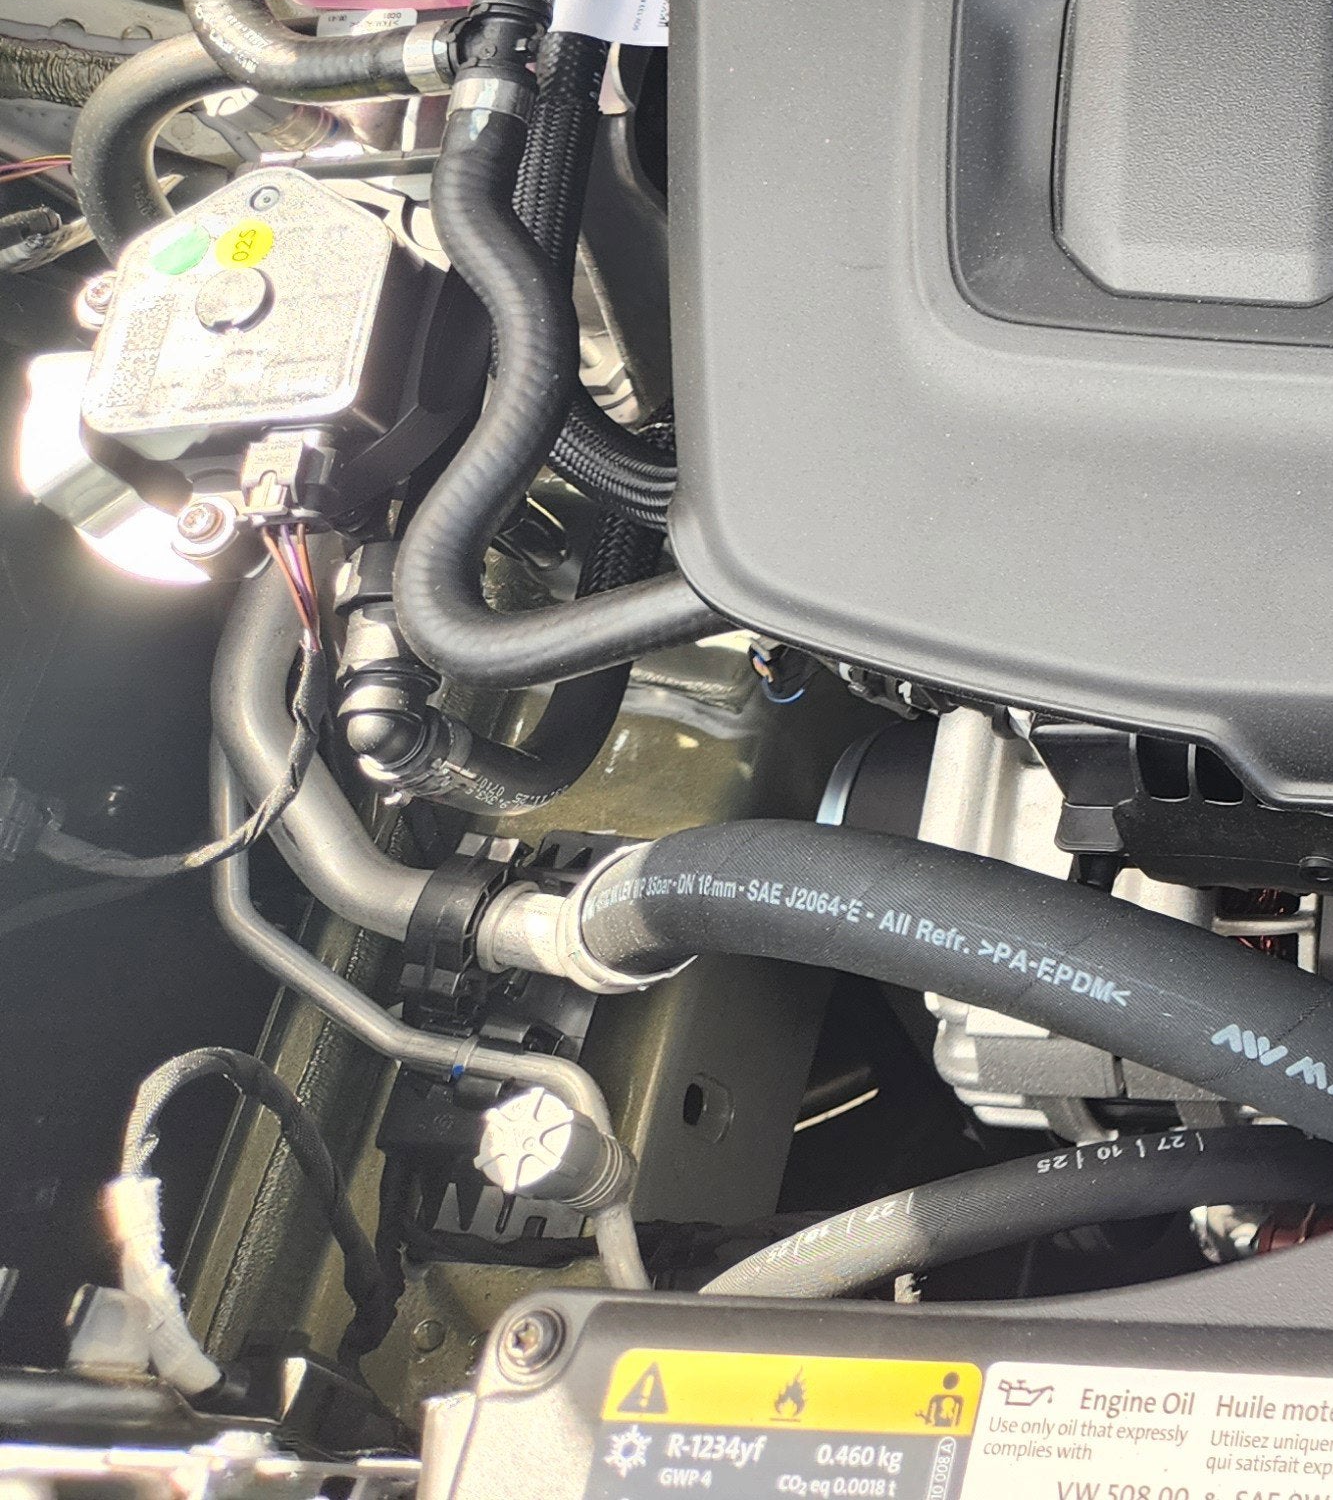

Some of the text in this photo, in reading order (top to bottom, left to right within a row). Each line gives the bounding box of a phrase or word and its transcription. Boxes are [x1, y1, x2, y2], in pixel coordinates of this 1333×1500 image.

[746, 879, 785, 906] SAE
[879, 909, 909, 937] All
[915, 917, 970, 955] Refr.
[1080, 1388, 1157, 1419] Engine
[1162, 1391, 1195, 1416] Oil
[1216, 1394, 1276, 1419] Huile
[988, 1417, 1189, 1447] Use only oil that expressly
[1210, 1429, 1270, 1450] Utilisez
[666, 1433, 903, 1474] R-1234yf 0.460 kg
[940, 1442, 953, 1453] A
[983, 1440, 1093, 1462] complies with
[935, 1456, 951, 1482] 008
[1206, 1454, 1232, 1474] qui
[1235, 1455, 1300, 1474] satisfait
[659, 1467, 712, 1488] GWP 4
[810, 1478, 831, 1499] eq
[833, 1476, 886, 1498] 0.0018
[888, 1478, 896, 1497] t
[1057, 1480, 1100, 1500] VW
[1108, 1484, 1151, 1500] 508
